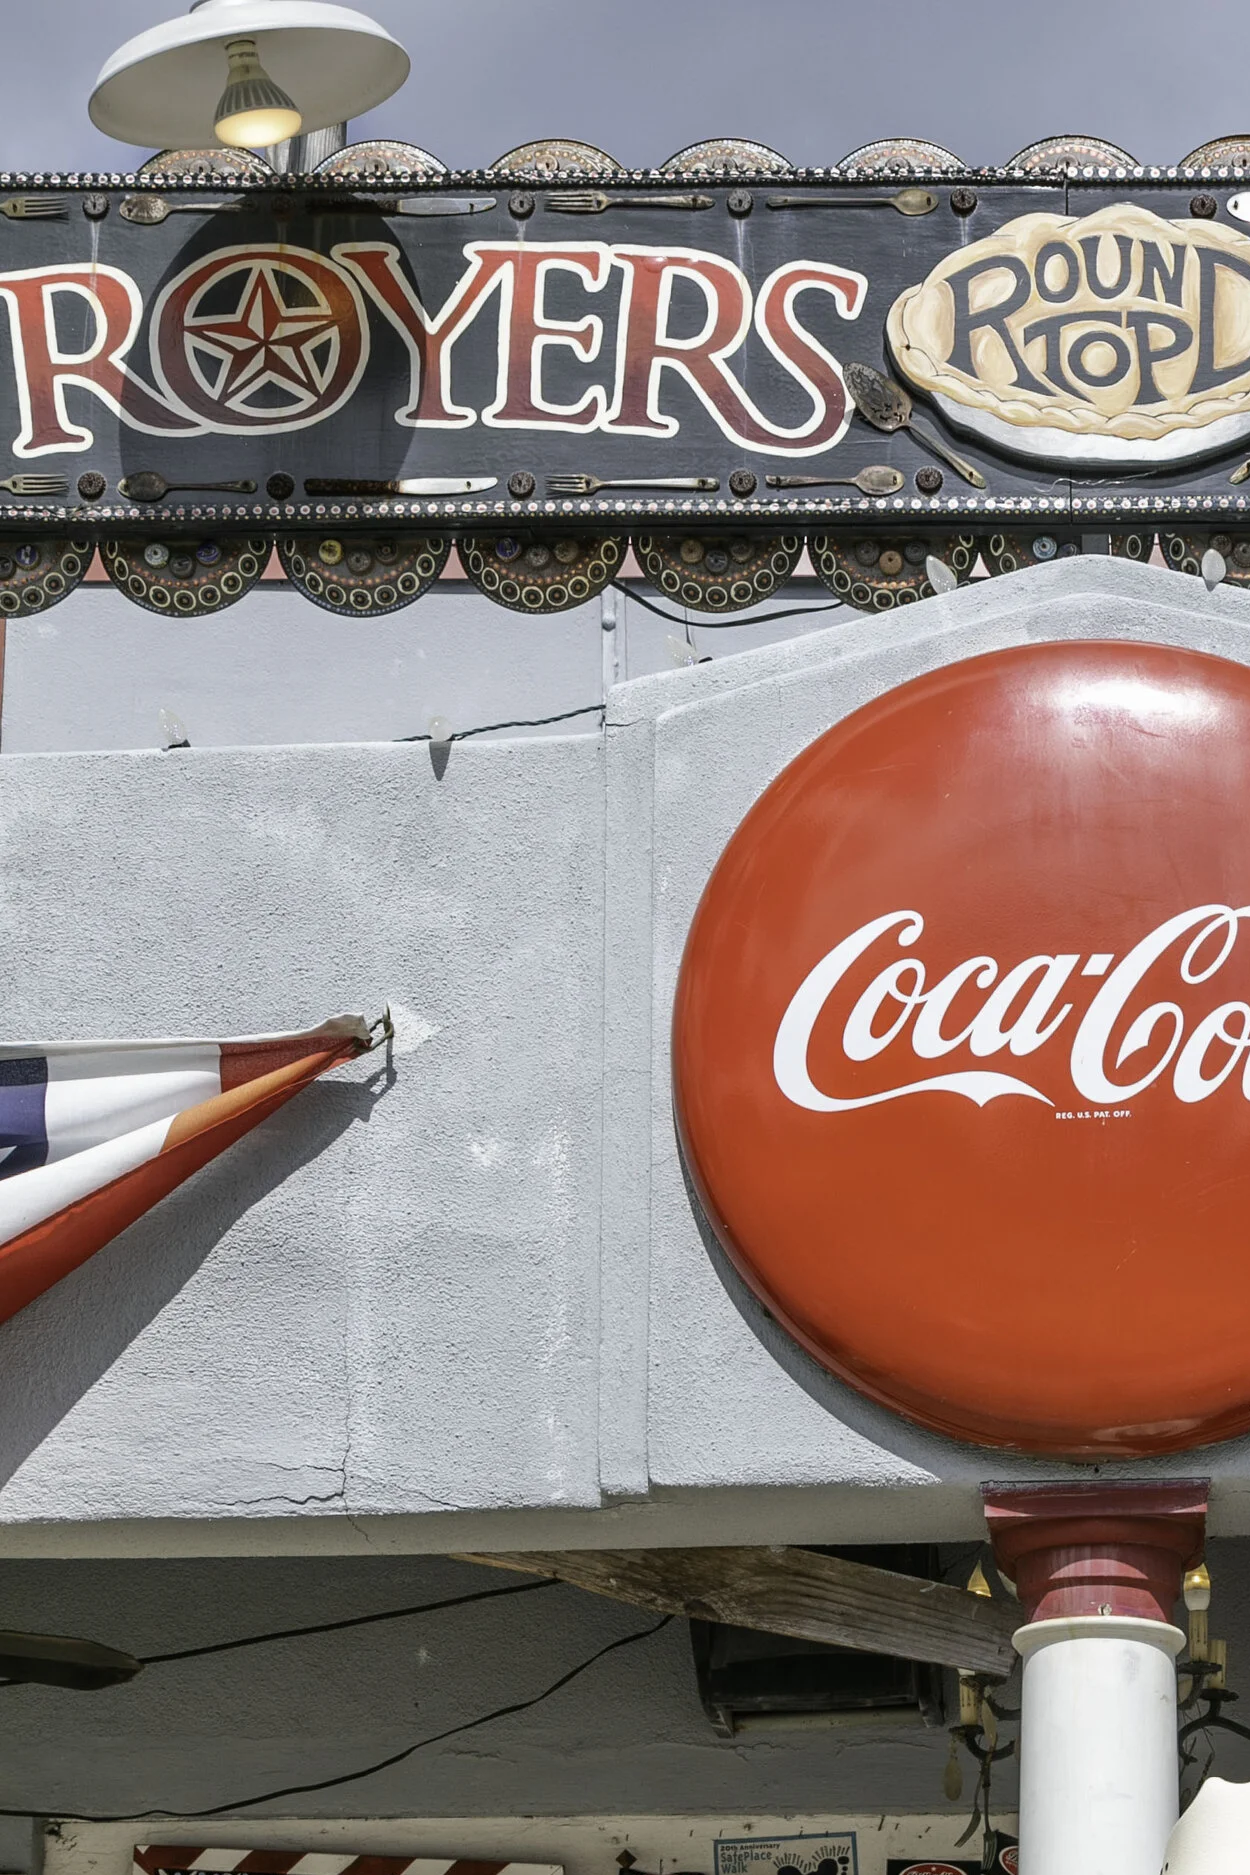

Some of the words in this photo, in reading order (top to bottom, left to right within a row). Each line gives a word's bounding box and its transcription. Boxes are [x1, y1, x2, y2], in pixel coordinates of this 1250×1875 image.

[0, 241, 869, 458] ROYERS
[1023, 308, 1194, 406] TOP
[1077, 1111, 1091, 1119] U.S.
[1094, 1110, 1110, 1118] PAT.
[1113, 1110, 1131, 1118] OFF.
[740, 1843, 781, 1851] Anniversary
[721, 1850, 772, 1863] SafePlace
[721, 1863, 748, 1874] Walk
